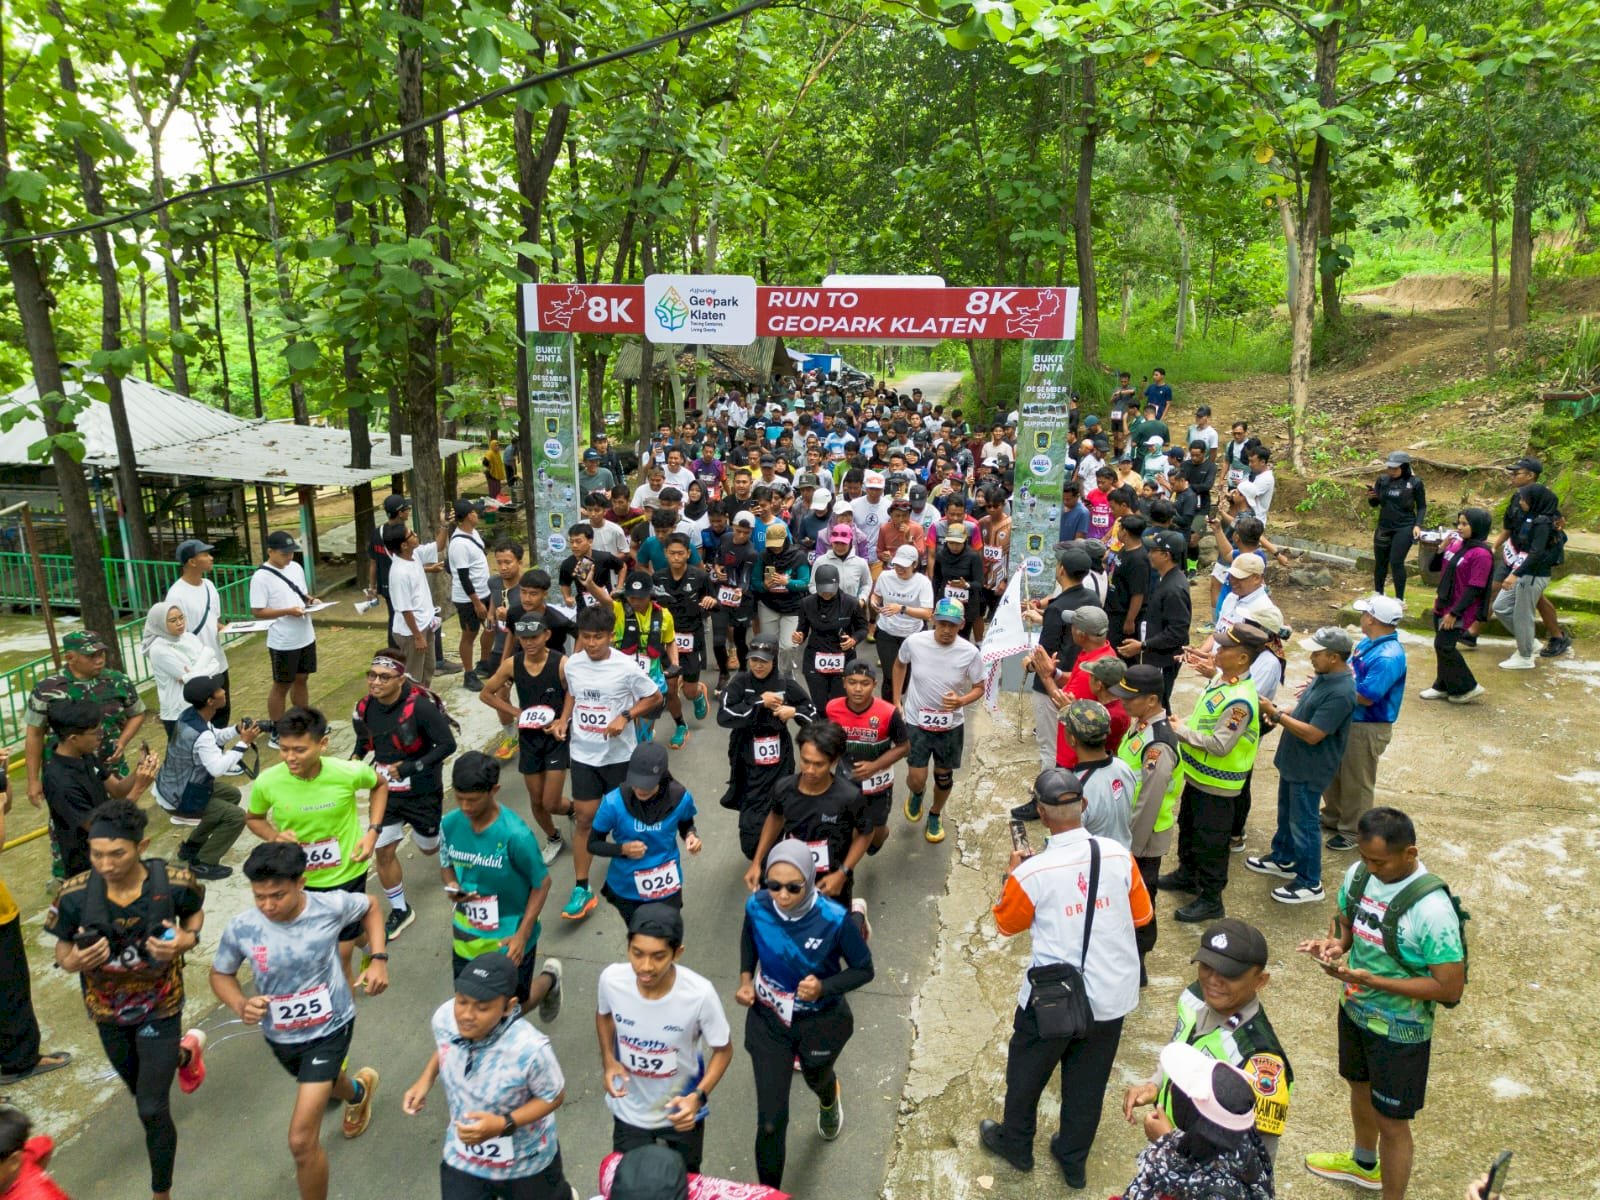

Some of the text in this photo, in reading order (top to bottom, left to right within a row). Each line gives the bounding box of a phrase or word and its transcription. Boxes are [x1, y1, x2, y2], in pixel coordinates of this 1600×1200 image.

[768, 291, 859, 309] RUN TO
[966, 290, 1018, 315] 8K
[587, 296, 634, 323] 8K
[690, 309, 726, 320] Klaten
[768, 315, 987, 334] GEOPARK KLATEN
[535, 345, 561, 354] BUKIT
[535, 354, 562, 363] CINTA
[1033, 354, 1064, 363] BUKIT
[1032, 363, 1064, 372] CINTA
[532, 374, 568, 382] DESEMBER
[1023, 420, 1065, 428] SUPPORT BY
[984, 548, 999, 557] 029
[947, 590, 966, 599] 344
[818, 658, 841, 667] 043
[525, 711, 547, 723] 184
[580, 713, 607, 725] 002
[922, 714, 948, 726] 243
[758, 744, 778, 757] 031
[870, 773, 890, 787] 132
[305, 848, 332, 862] 66
[641, 872, 673, 891] 026
[1065, 897, 1110, 917] ORRI
[279, 999, 322, 1020] 225
[629, 1053, 663, 1071] 139
